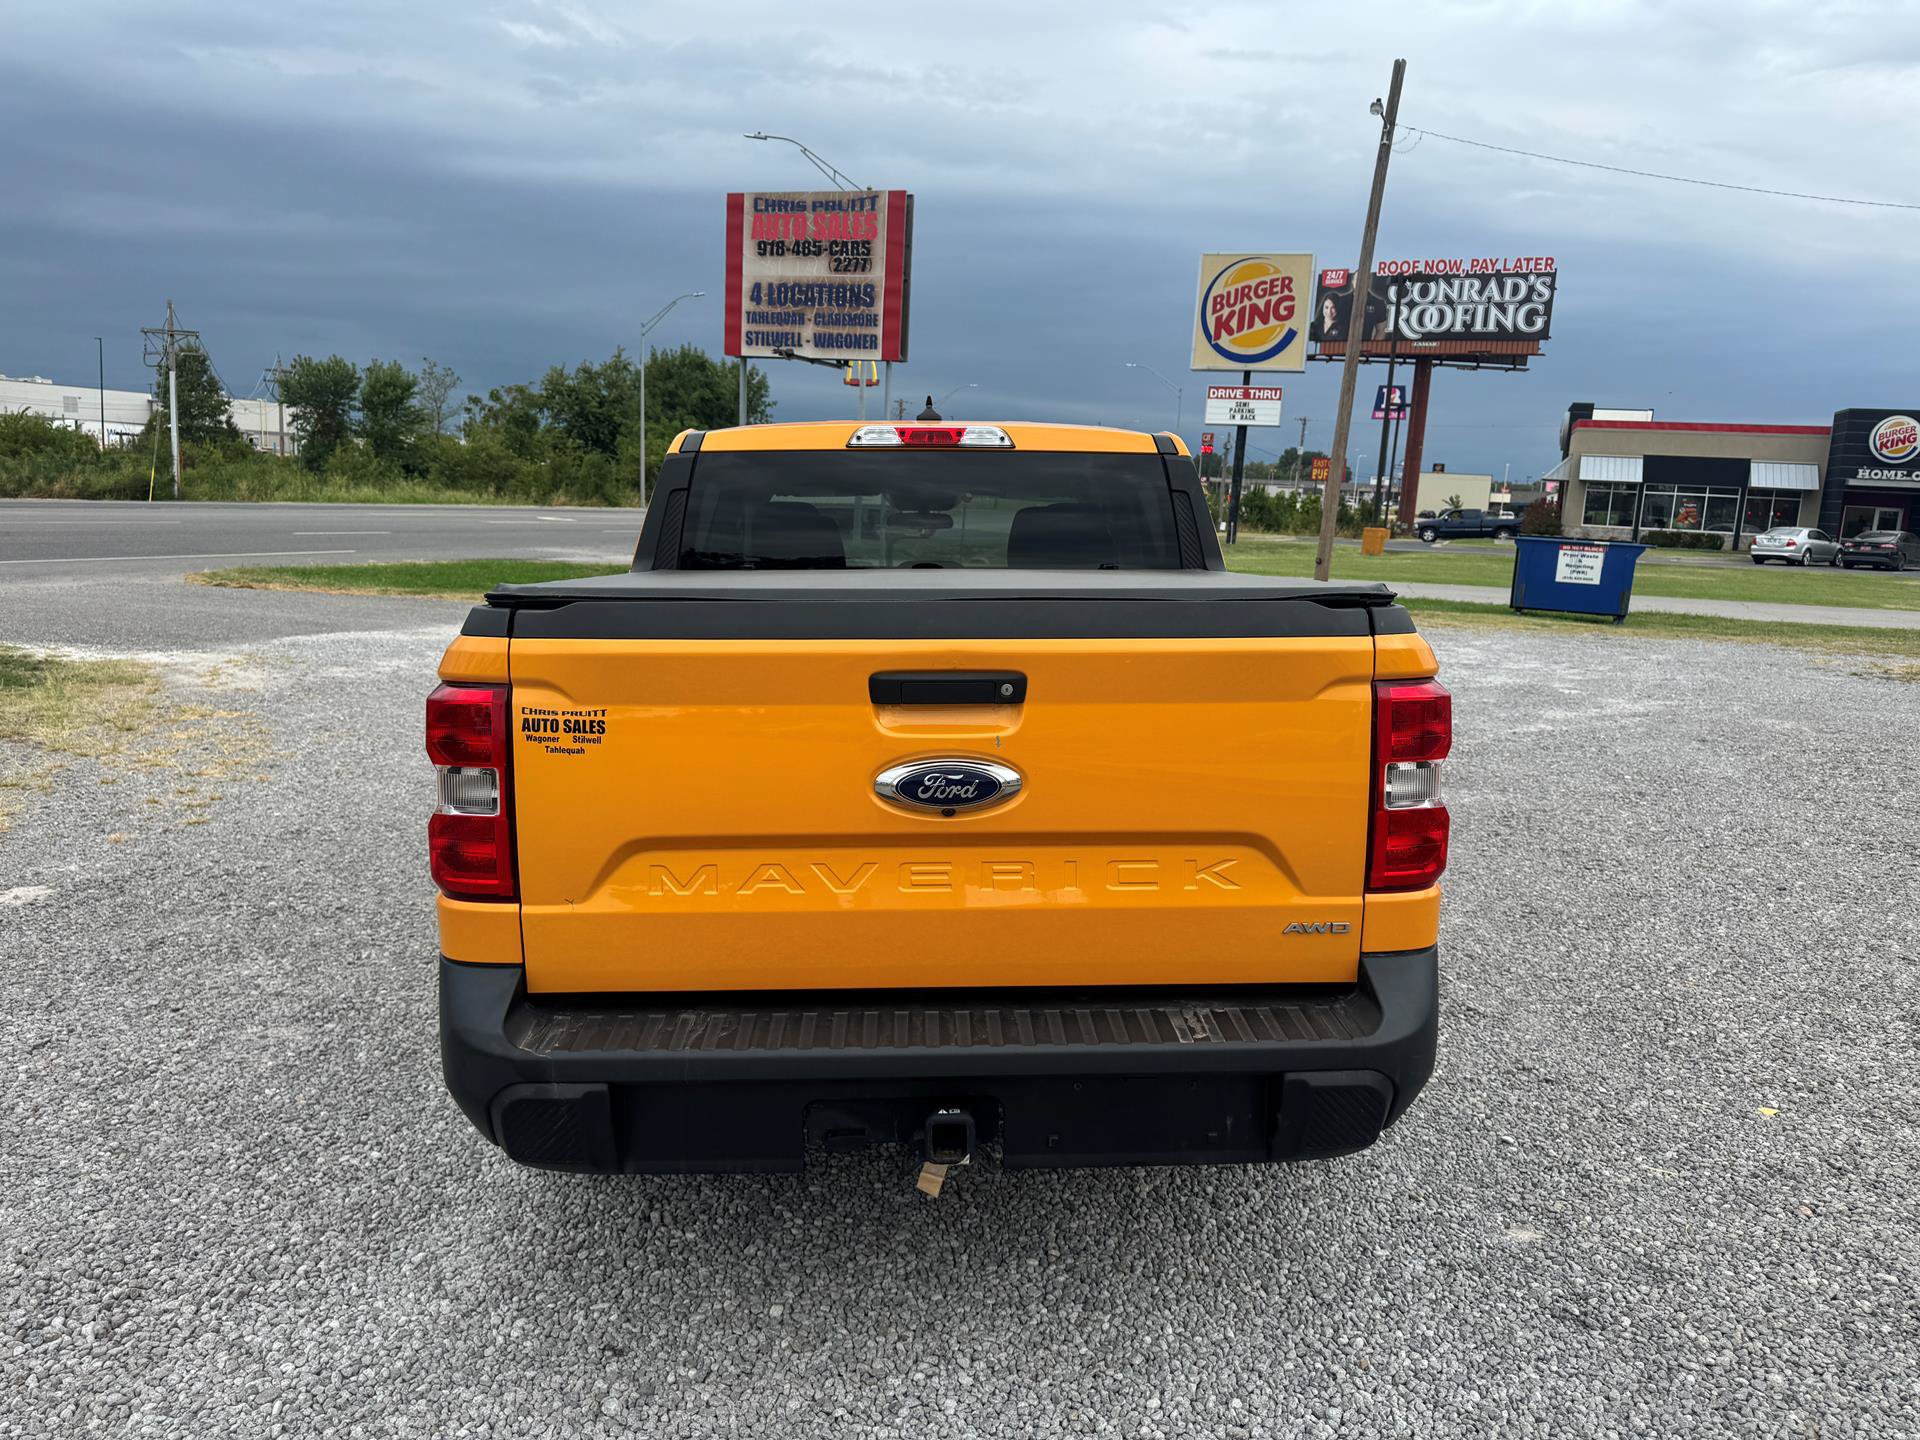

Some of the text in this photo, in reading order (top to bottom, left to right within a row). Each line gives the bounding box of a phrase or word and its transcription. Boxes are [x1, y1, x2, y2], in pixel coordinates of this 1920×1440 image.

[753, 195, 879, 212] CHRIS PRUITT
[751, 212, 878, 241] AUTO SALES
[757, 240, 871, 257] 918-485-CARS
[828, 257, 873, 273] (2277)
[1377, 256, 1556, 277] ROOF NOW, PAY LATER
[1326, 270, 1344, 279] 24/7
[750, 282, 876, 308] 4 LOCATIONS
[1212, 276, 1294, 316] BURGER
[1387, 275, 1552, 304] CONRAD'S
[746, 311, 805, 327] TAHLEQUAH
[1212, 294, 1296, 342] KING
[1385, 302, 1547, 340] ROOFING
[745, 331, 803, 348] STILWELL
[813, 332, 878, 350] WAGONER
[1209, 388, 1281, 400] DRIVE THRU
[1878, 425, 1917, 442] BURGER
[1878, 433, 1918, 452] KING
[1313, 458, 1328, 467] EAST
[1856, 468, 1908, 480] HOME
[521, 707, 608, 717] CHRIS PRUITT
[521, 718, 606, 735] AUTO SALES
[525, 734, 602, 744] Wagoner Stilwell
[545, 745, 585, 755] Tahlequah
[917, 773, 979, 799] Ford
[648, 858, 1241, 896] MAVERICK
[1282, 922, 1351, 934] AWD
